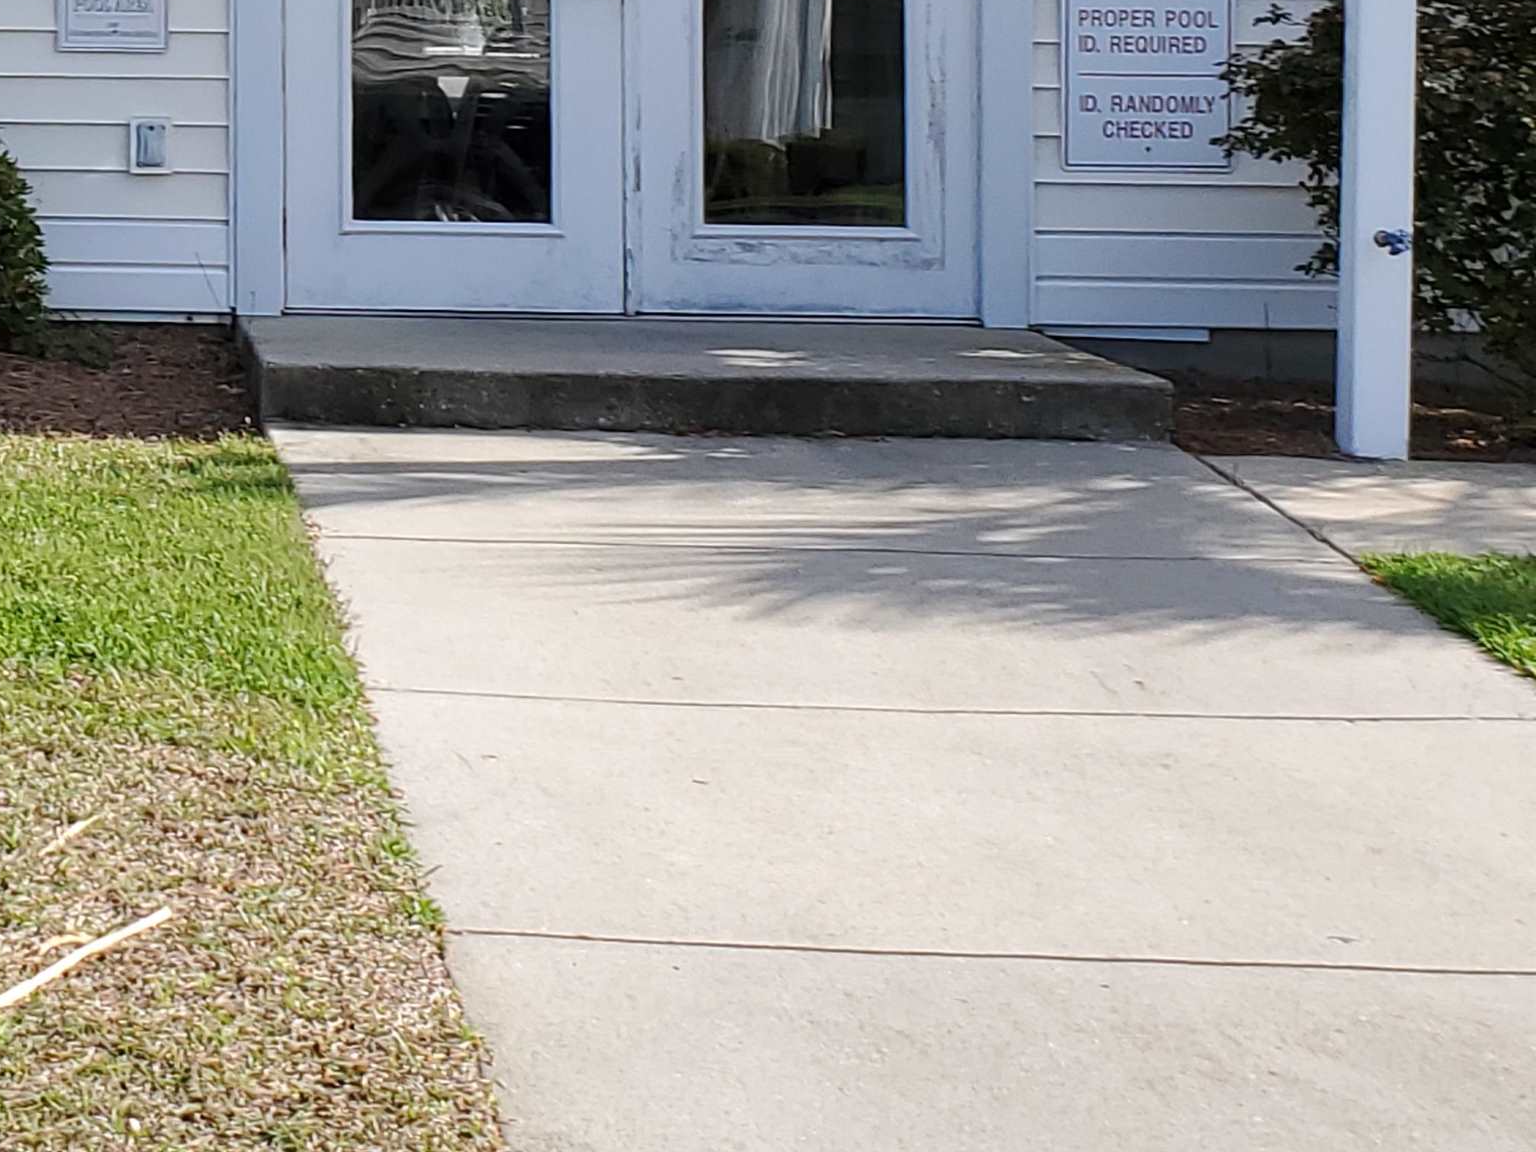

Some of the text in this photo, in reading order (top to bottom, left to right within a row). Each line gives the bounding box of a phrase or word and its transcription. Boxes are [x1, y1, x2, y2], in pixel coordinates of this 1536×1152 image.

[1078, 9, 1219, 28] PROPER POOL
[1110, 36, 1207, 54] REQUIRED
[1110, 95, 1215, 114] RANDOMLY
[1102, 120, 1194, 139] CHECKED
